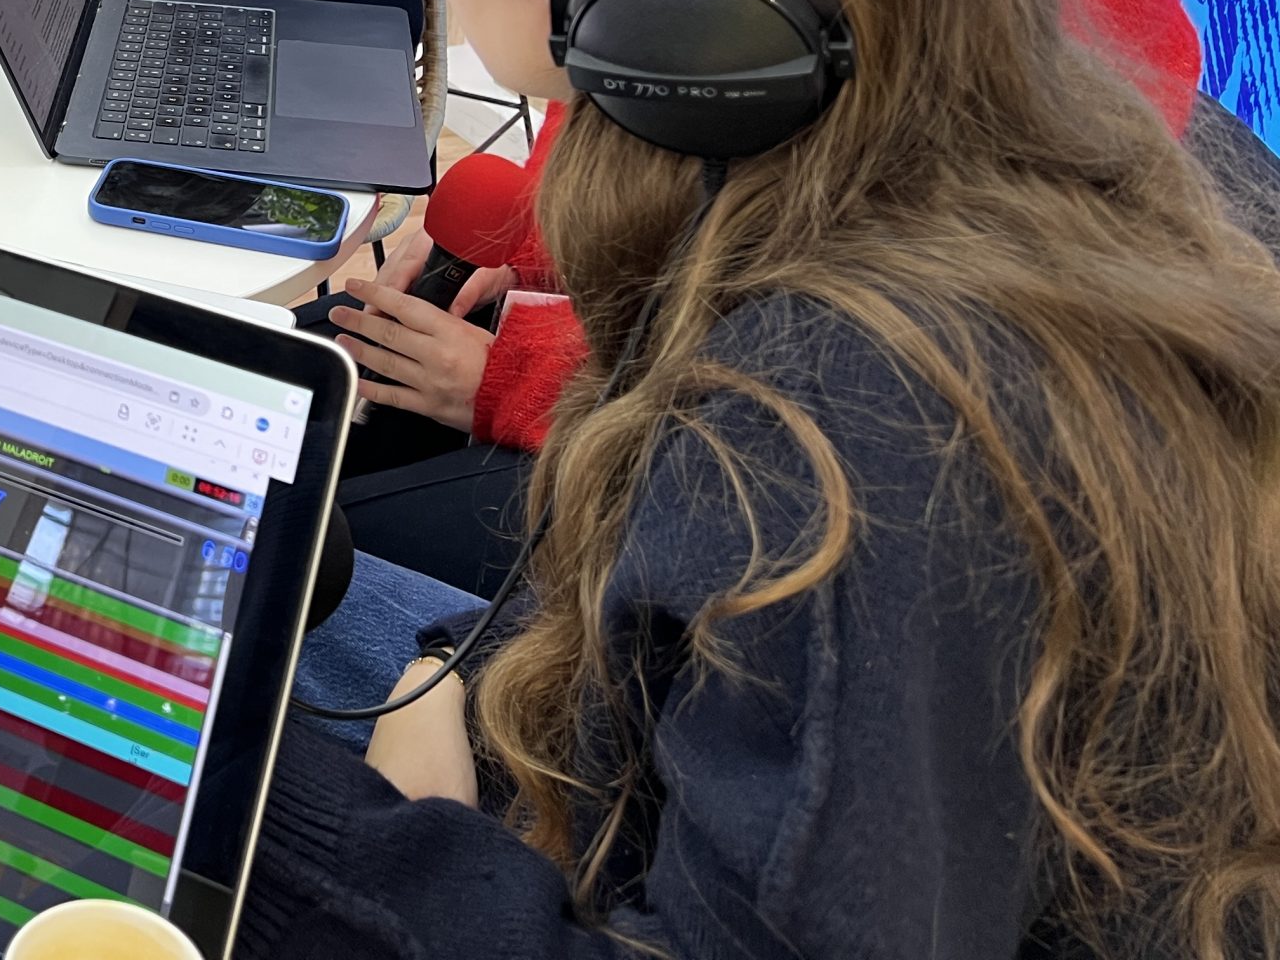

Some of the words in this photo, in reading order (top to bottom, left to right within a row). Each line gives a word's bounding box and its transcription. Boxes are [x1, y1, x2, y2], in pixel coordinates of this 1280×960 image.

[603, 79, 627, 90] DT
[632, 83, 669, 96] 770
[677, 87, 718, 98] PRO
[1, 441, 55, 469] MALADROIT
